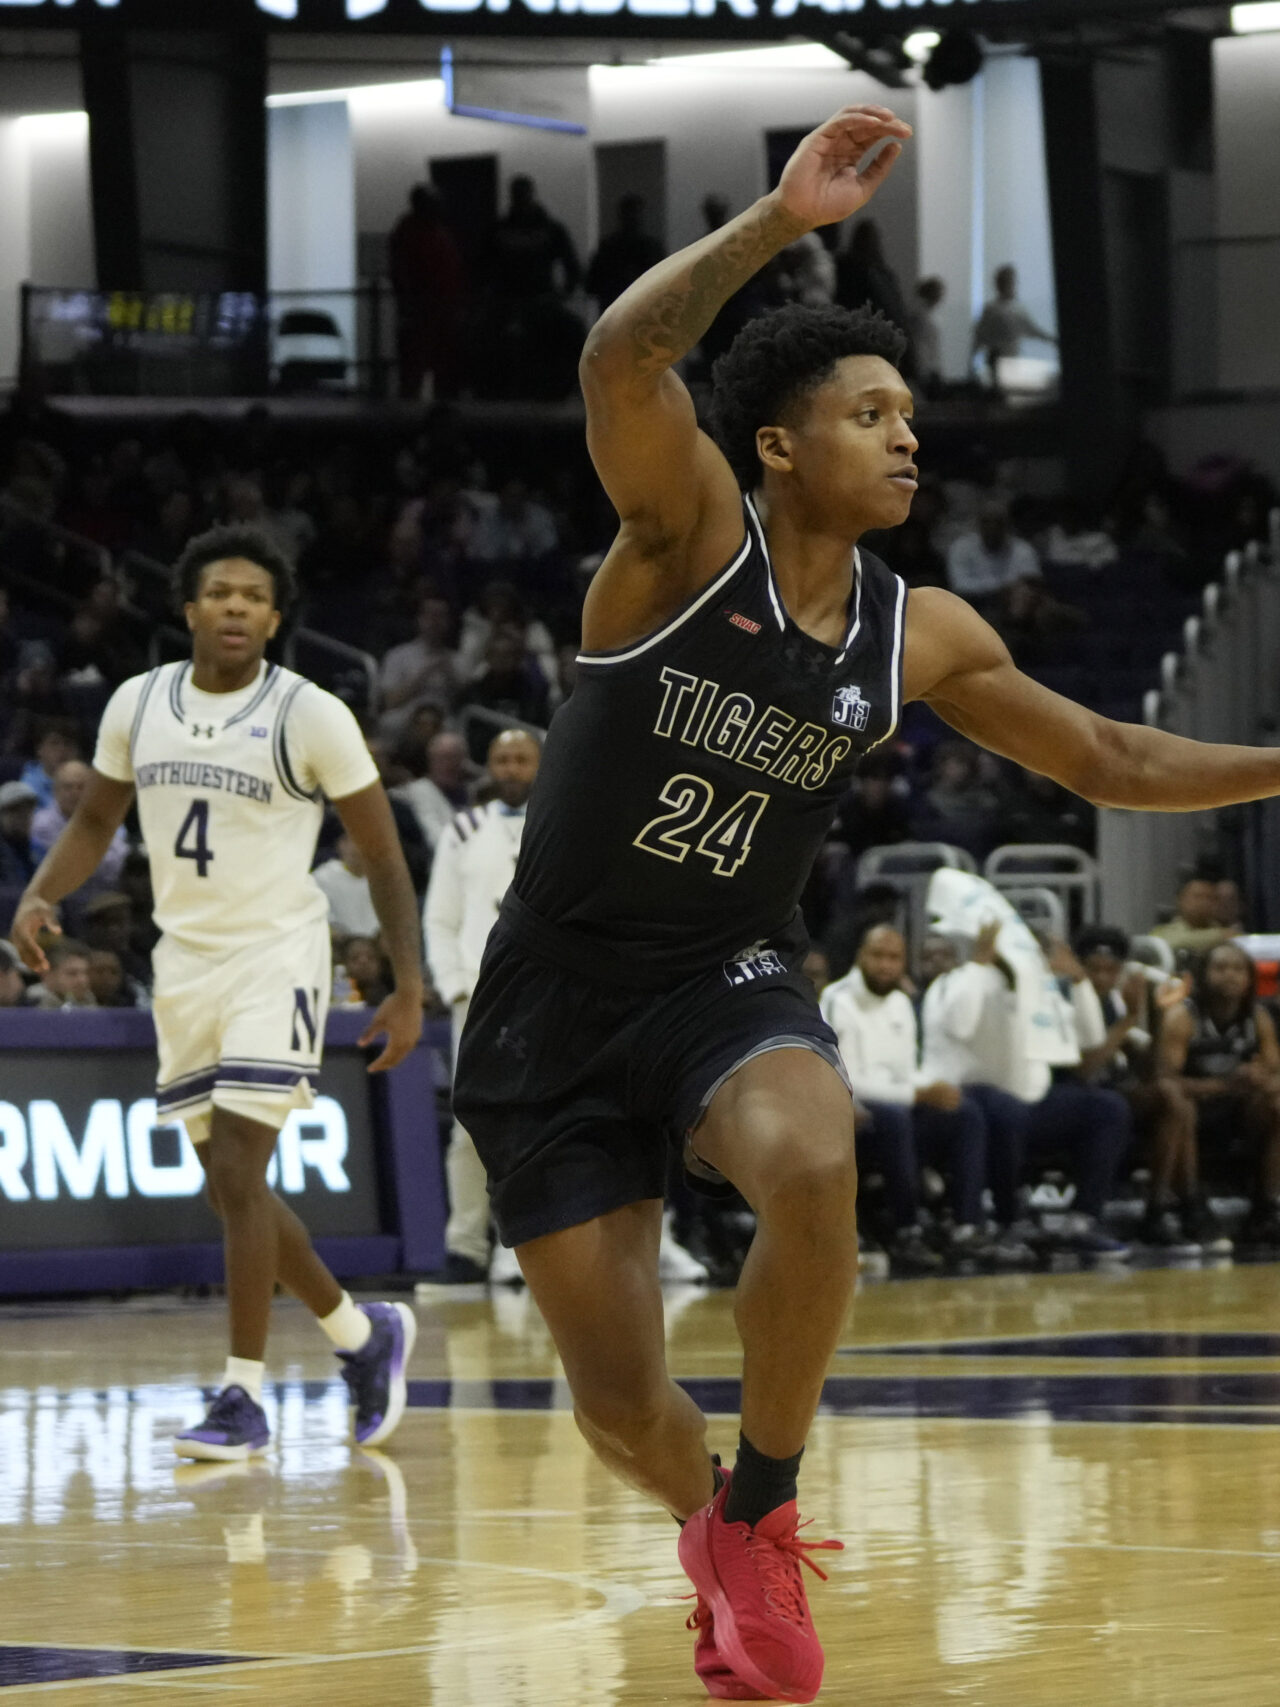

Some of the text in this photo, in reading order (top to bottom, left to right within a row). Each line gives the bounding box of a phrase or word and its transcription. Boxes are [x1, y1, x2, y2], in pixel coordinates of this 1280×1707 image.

[729, 613, 762, 635] SWAC
[653, 667, 852, 790] TIGERS
[175, 799, 214, 877] 4
[632, 772, 771, 878] 24
[290, 987, 319, 1053] N
[0, 1096, 351, 1201] MOR
